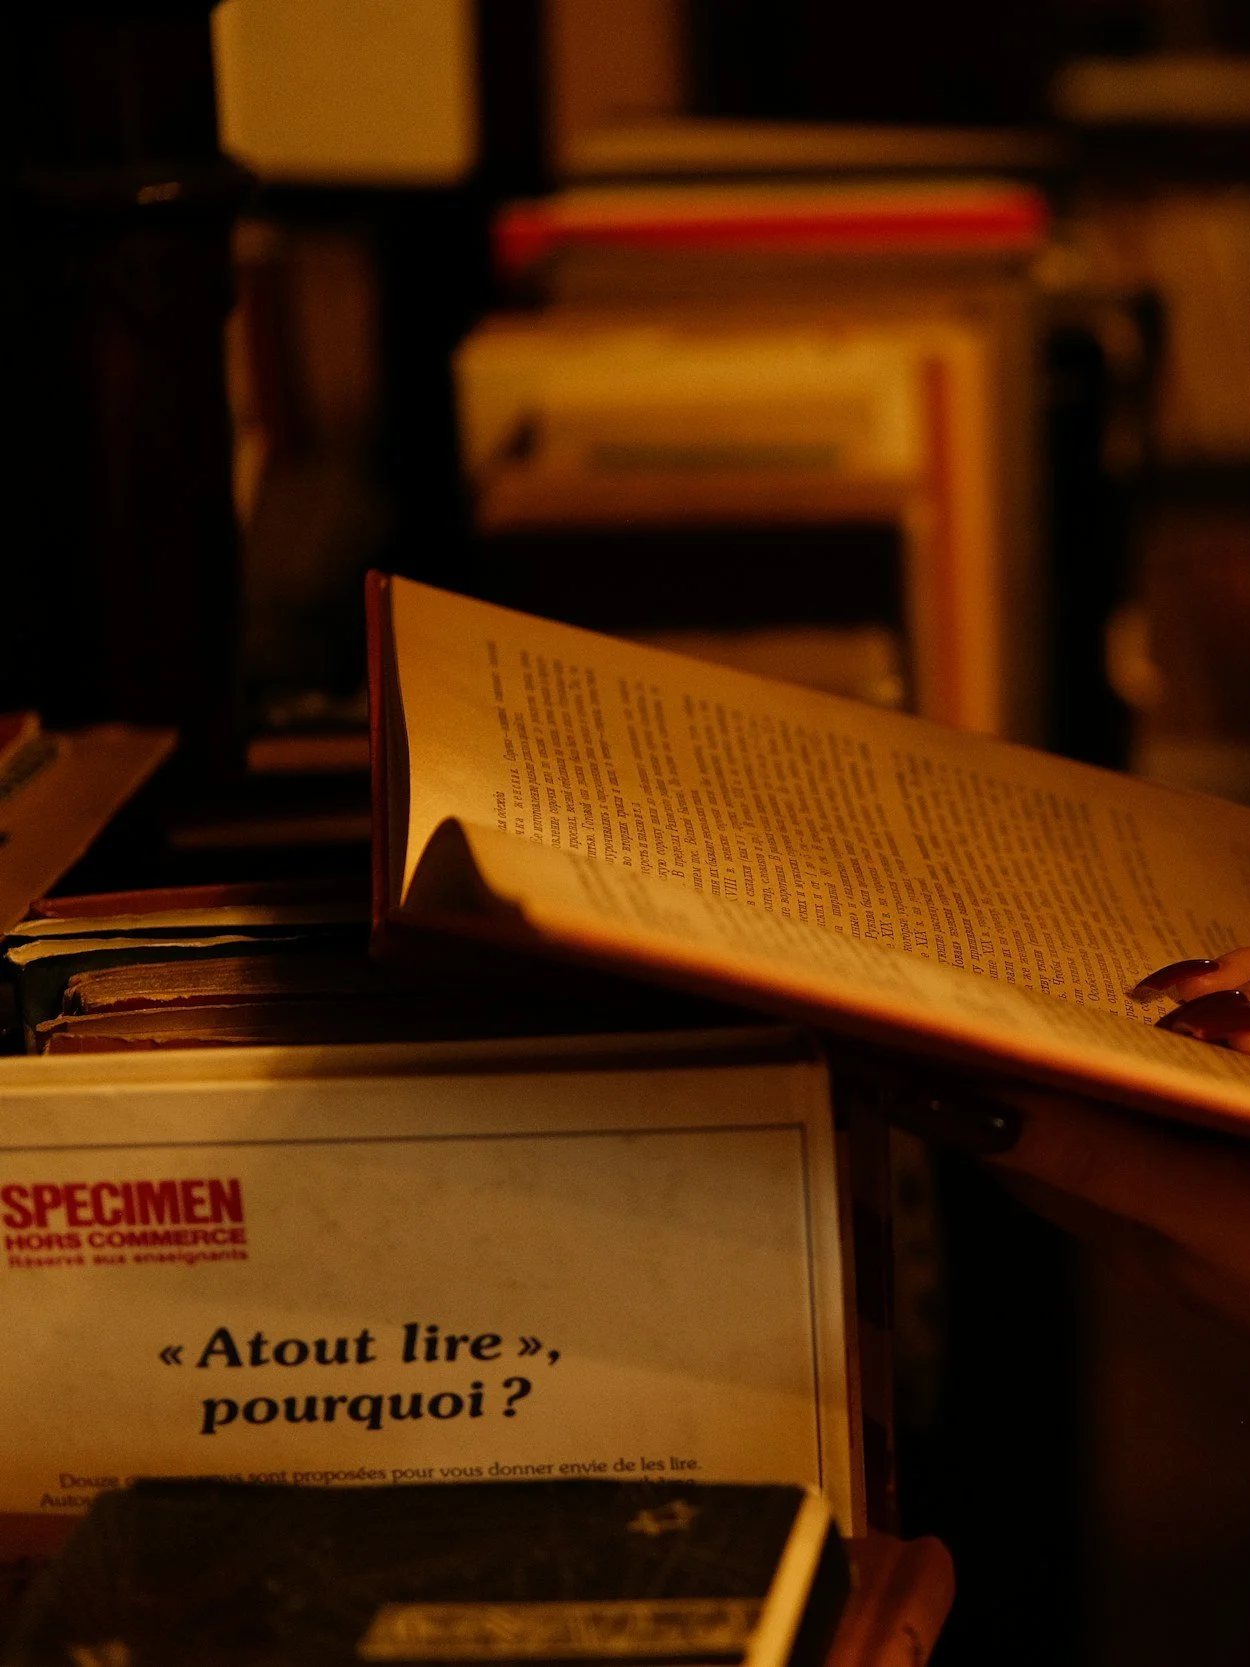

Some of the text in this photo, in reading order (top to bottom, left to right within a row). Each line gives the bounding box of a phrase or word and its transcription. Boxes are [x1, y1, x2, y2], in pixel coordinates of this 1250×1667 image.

[528, 784, 544, 831] изготовление
[579, 802, 595, 830] Готовой
[549, 816, 562, 848] овление
[618, 821, 633, 851] вторник
[622, 856, 632, 866] во
[656, 859, 670, 880] скую
[742, 864, 756, 896] складки
[797, 899, 808, 921] ских
[823, 882, 843, 916] шириной
[814, 903, 826, 926] ских
[864, 910, 880, 940] Рукава
[879, 920, 895, 940] XIX
[899, 918, 913, 951] которые
[914, 929, 929, 948] XIX
[962, 918, 982, 962] пришивали
[979, 937, 996, 957] XIX
[1039, 975, 1052, 995] ству
[1049, 960, 1066, 985] Чтобы
[1074, 988, 1085, 1005] али
[1, 1179, 243, 1228] SPECIMEN
[5, 1229, 247, 1249] HORS COMMERCE
[93, 1254, 126, 1264] aux
[133, 1250, 248, 1265] enseignants
[196, 1327, 377, 1368] Atout
[402, 1323, 503, 1364] lire
[200, 1382, 486, 1434] pourquoi
[59, 1473, 117, 1489] Douze
[247, 1470, 287, 1484] sont
[293, 1466, 386, 1486] proposées
[391, 1467, 434, 1483] pour
[440, 1465, 482, 1478] vous
[488, 1461, 553, 1477] donner
[558, 1459, 608, 1474] envie
[613, 1457, 637, 1472] de
[640, 1456, 665, 1471] les
[670, 1455, 703, 1471] lire.
